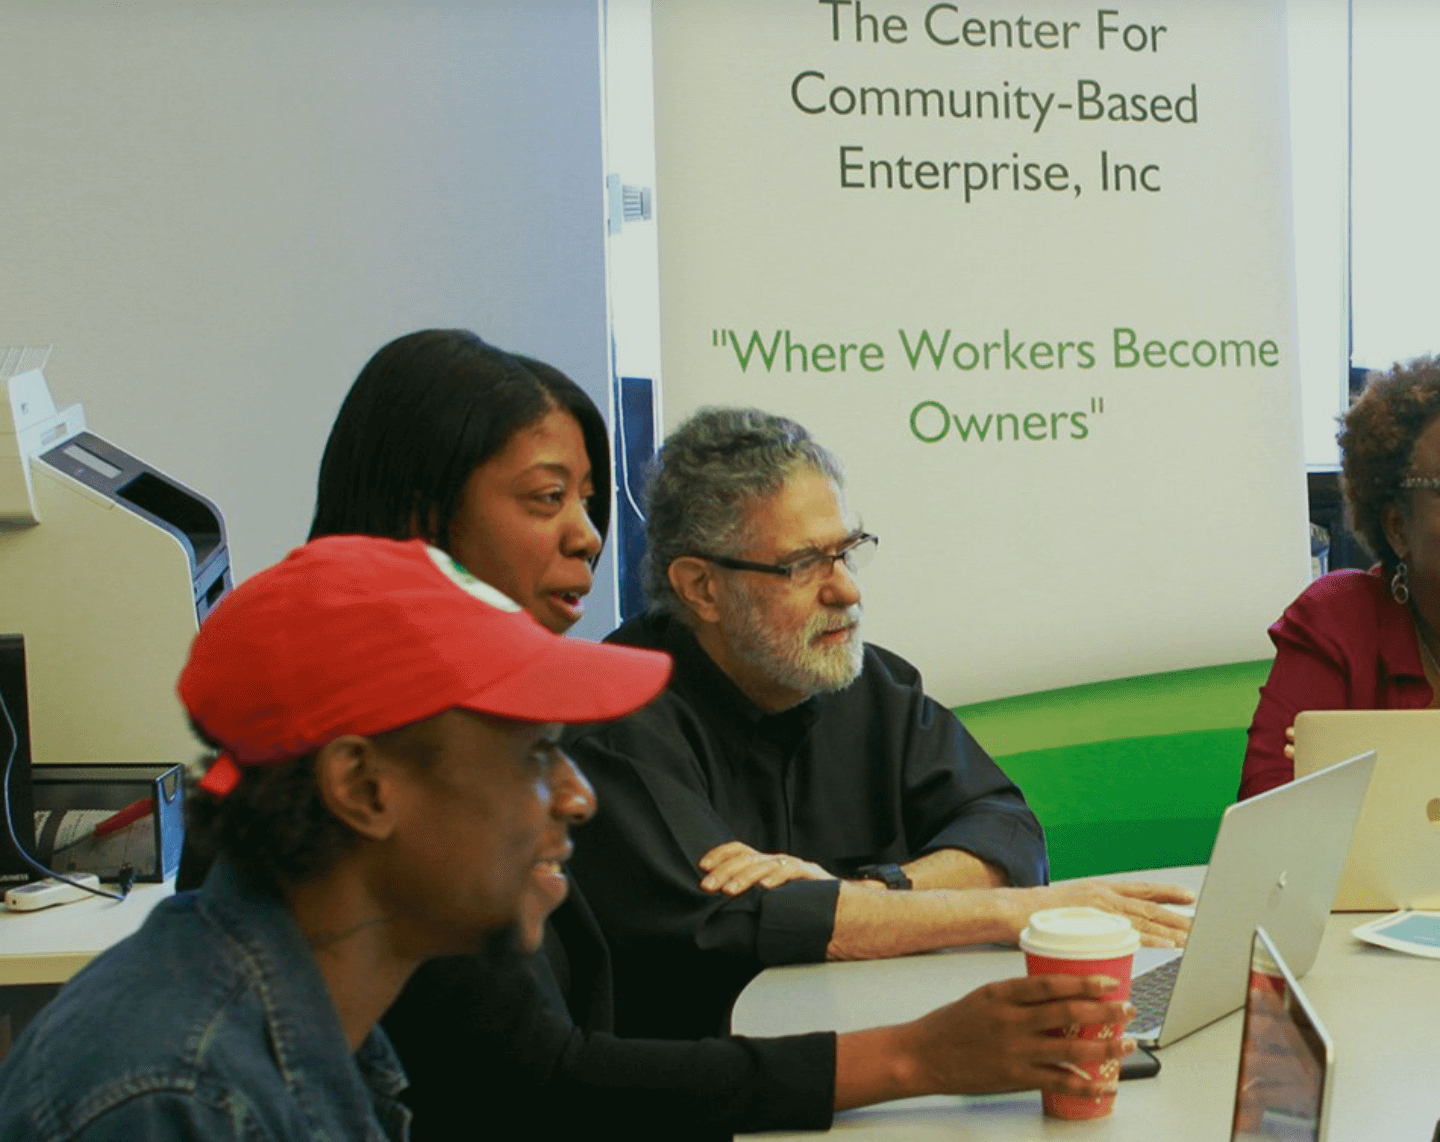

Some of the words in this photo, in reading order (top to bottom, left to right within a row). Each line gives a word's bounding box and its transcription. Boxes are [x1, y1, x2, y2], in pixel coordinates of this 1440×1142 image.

[819, 0, 908, 44] The
[924, 2, 1080, 50] Center
[1097, 8, 1168, 53] For
[790, 70, 1198, 133] Community-Based
[839, 146, 1082, 203] Enterprise,
[1100, 150, 1161, 193] Inc
[712, 329, 885, 373] "Where
[899, 329, 1096, 371] Workers
[1113, 328, 1279, 369] Become
[909, 398, 1104, 444] Owners"
